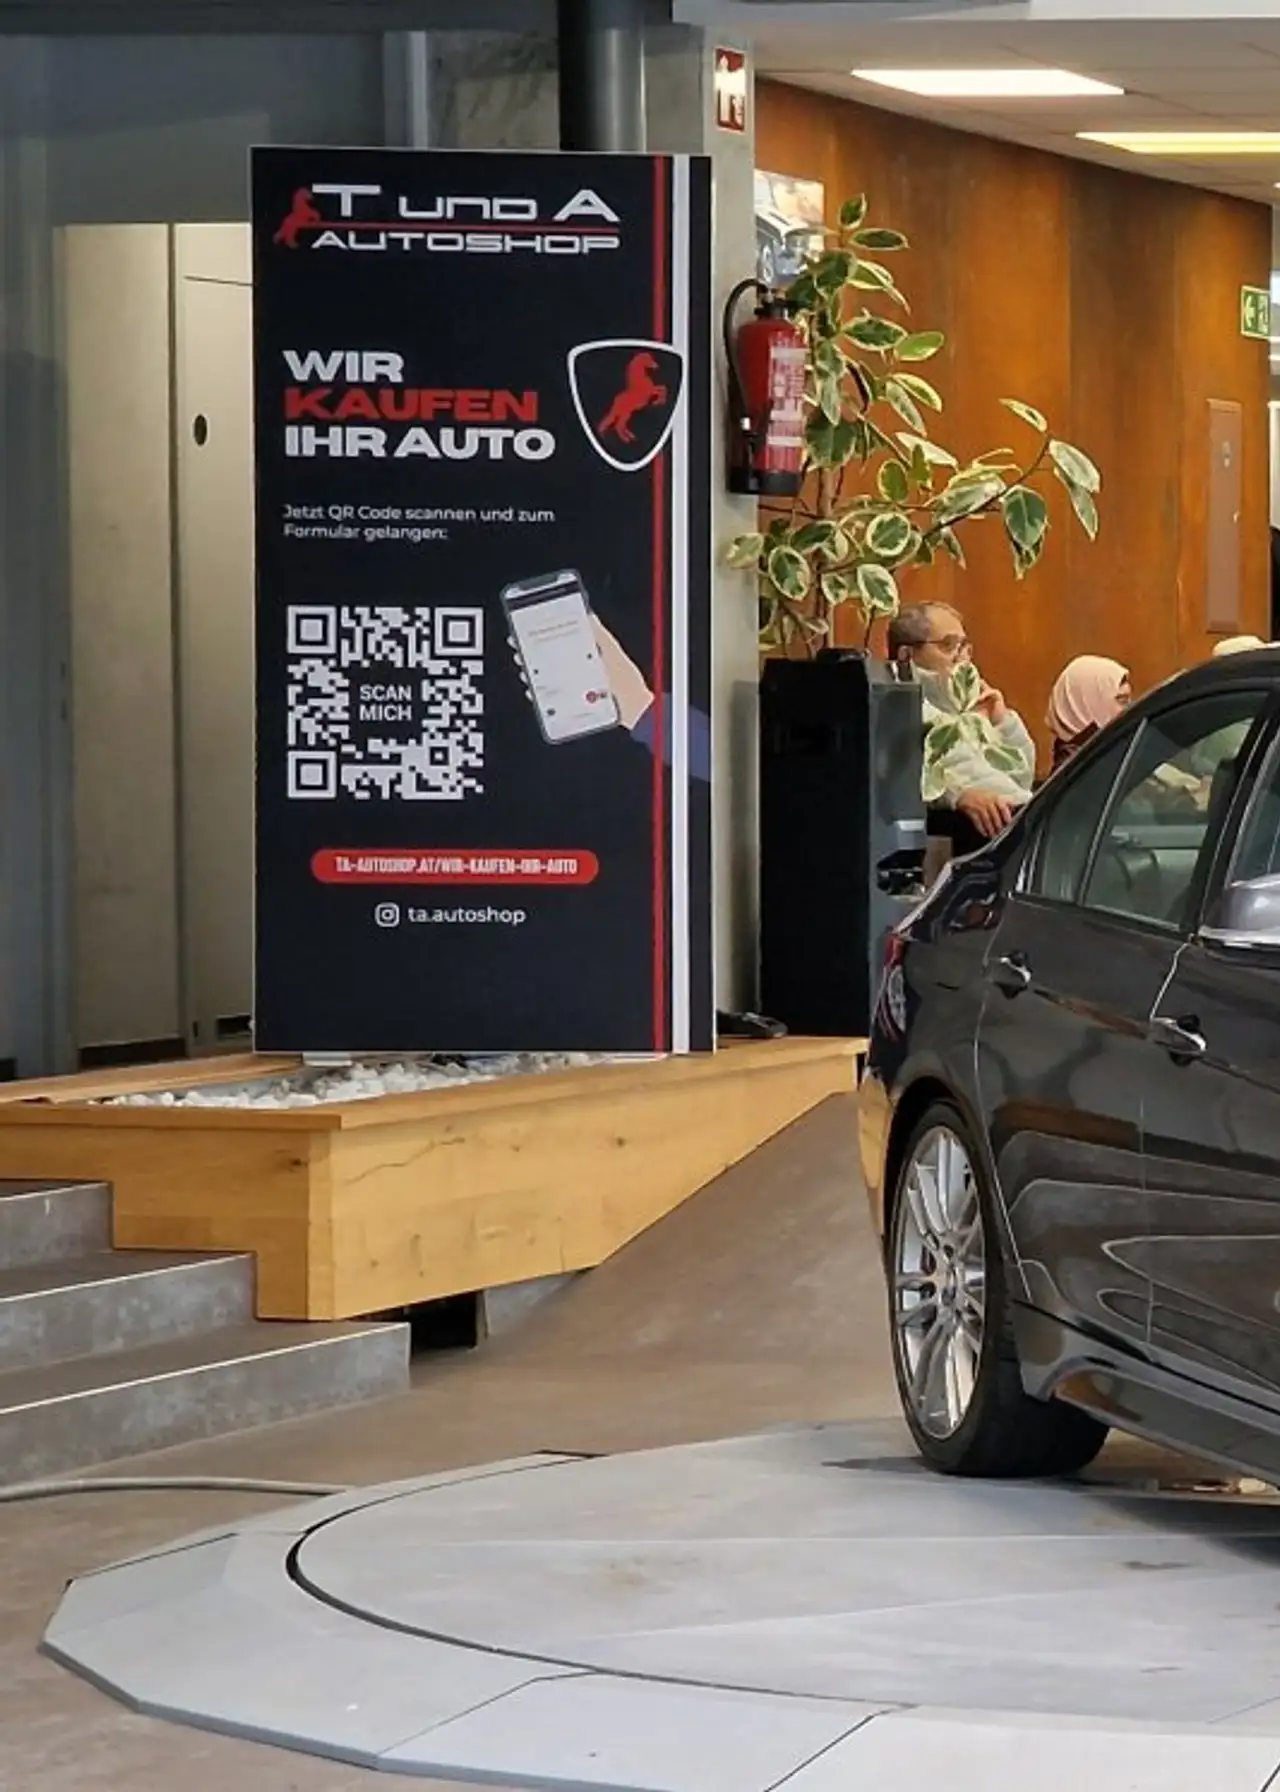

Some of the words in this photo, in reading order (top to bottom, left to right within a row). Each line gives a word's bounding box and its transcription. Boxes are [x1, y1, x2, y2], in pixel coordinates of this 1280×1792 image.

[312, 184, 381, 217] T
[552, 189, 620, 222] A
[311, 231, 620, 254] AUTOSHOP
[283, 350, 404, 383] WIR
[284, 387, 538, 421] KAUFEN
[285, 425, 387, 457] IHR
[394, 426, 556, 460] AUTO
[283, 504, 325, 520] Jetzt
[328, 505, 354, 521] QR
[358, 505, 400, 520] Code
[405, 508, 476, 521] scannen
[480, 507, 513, 522] und
[518, 510, 555, 522] zum
[283, 524, 360, 539] Formular
[363, 524, 448, 543] gelangen:
[360, 684, 412, 701] SCAN
[360, 704, 412, 721] MICH
[407, 906, 526, 926] ta.autoshop
